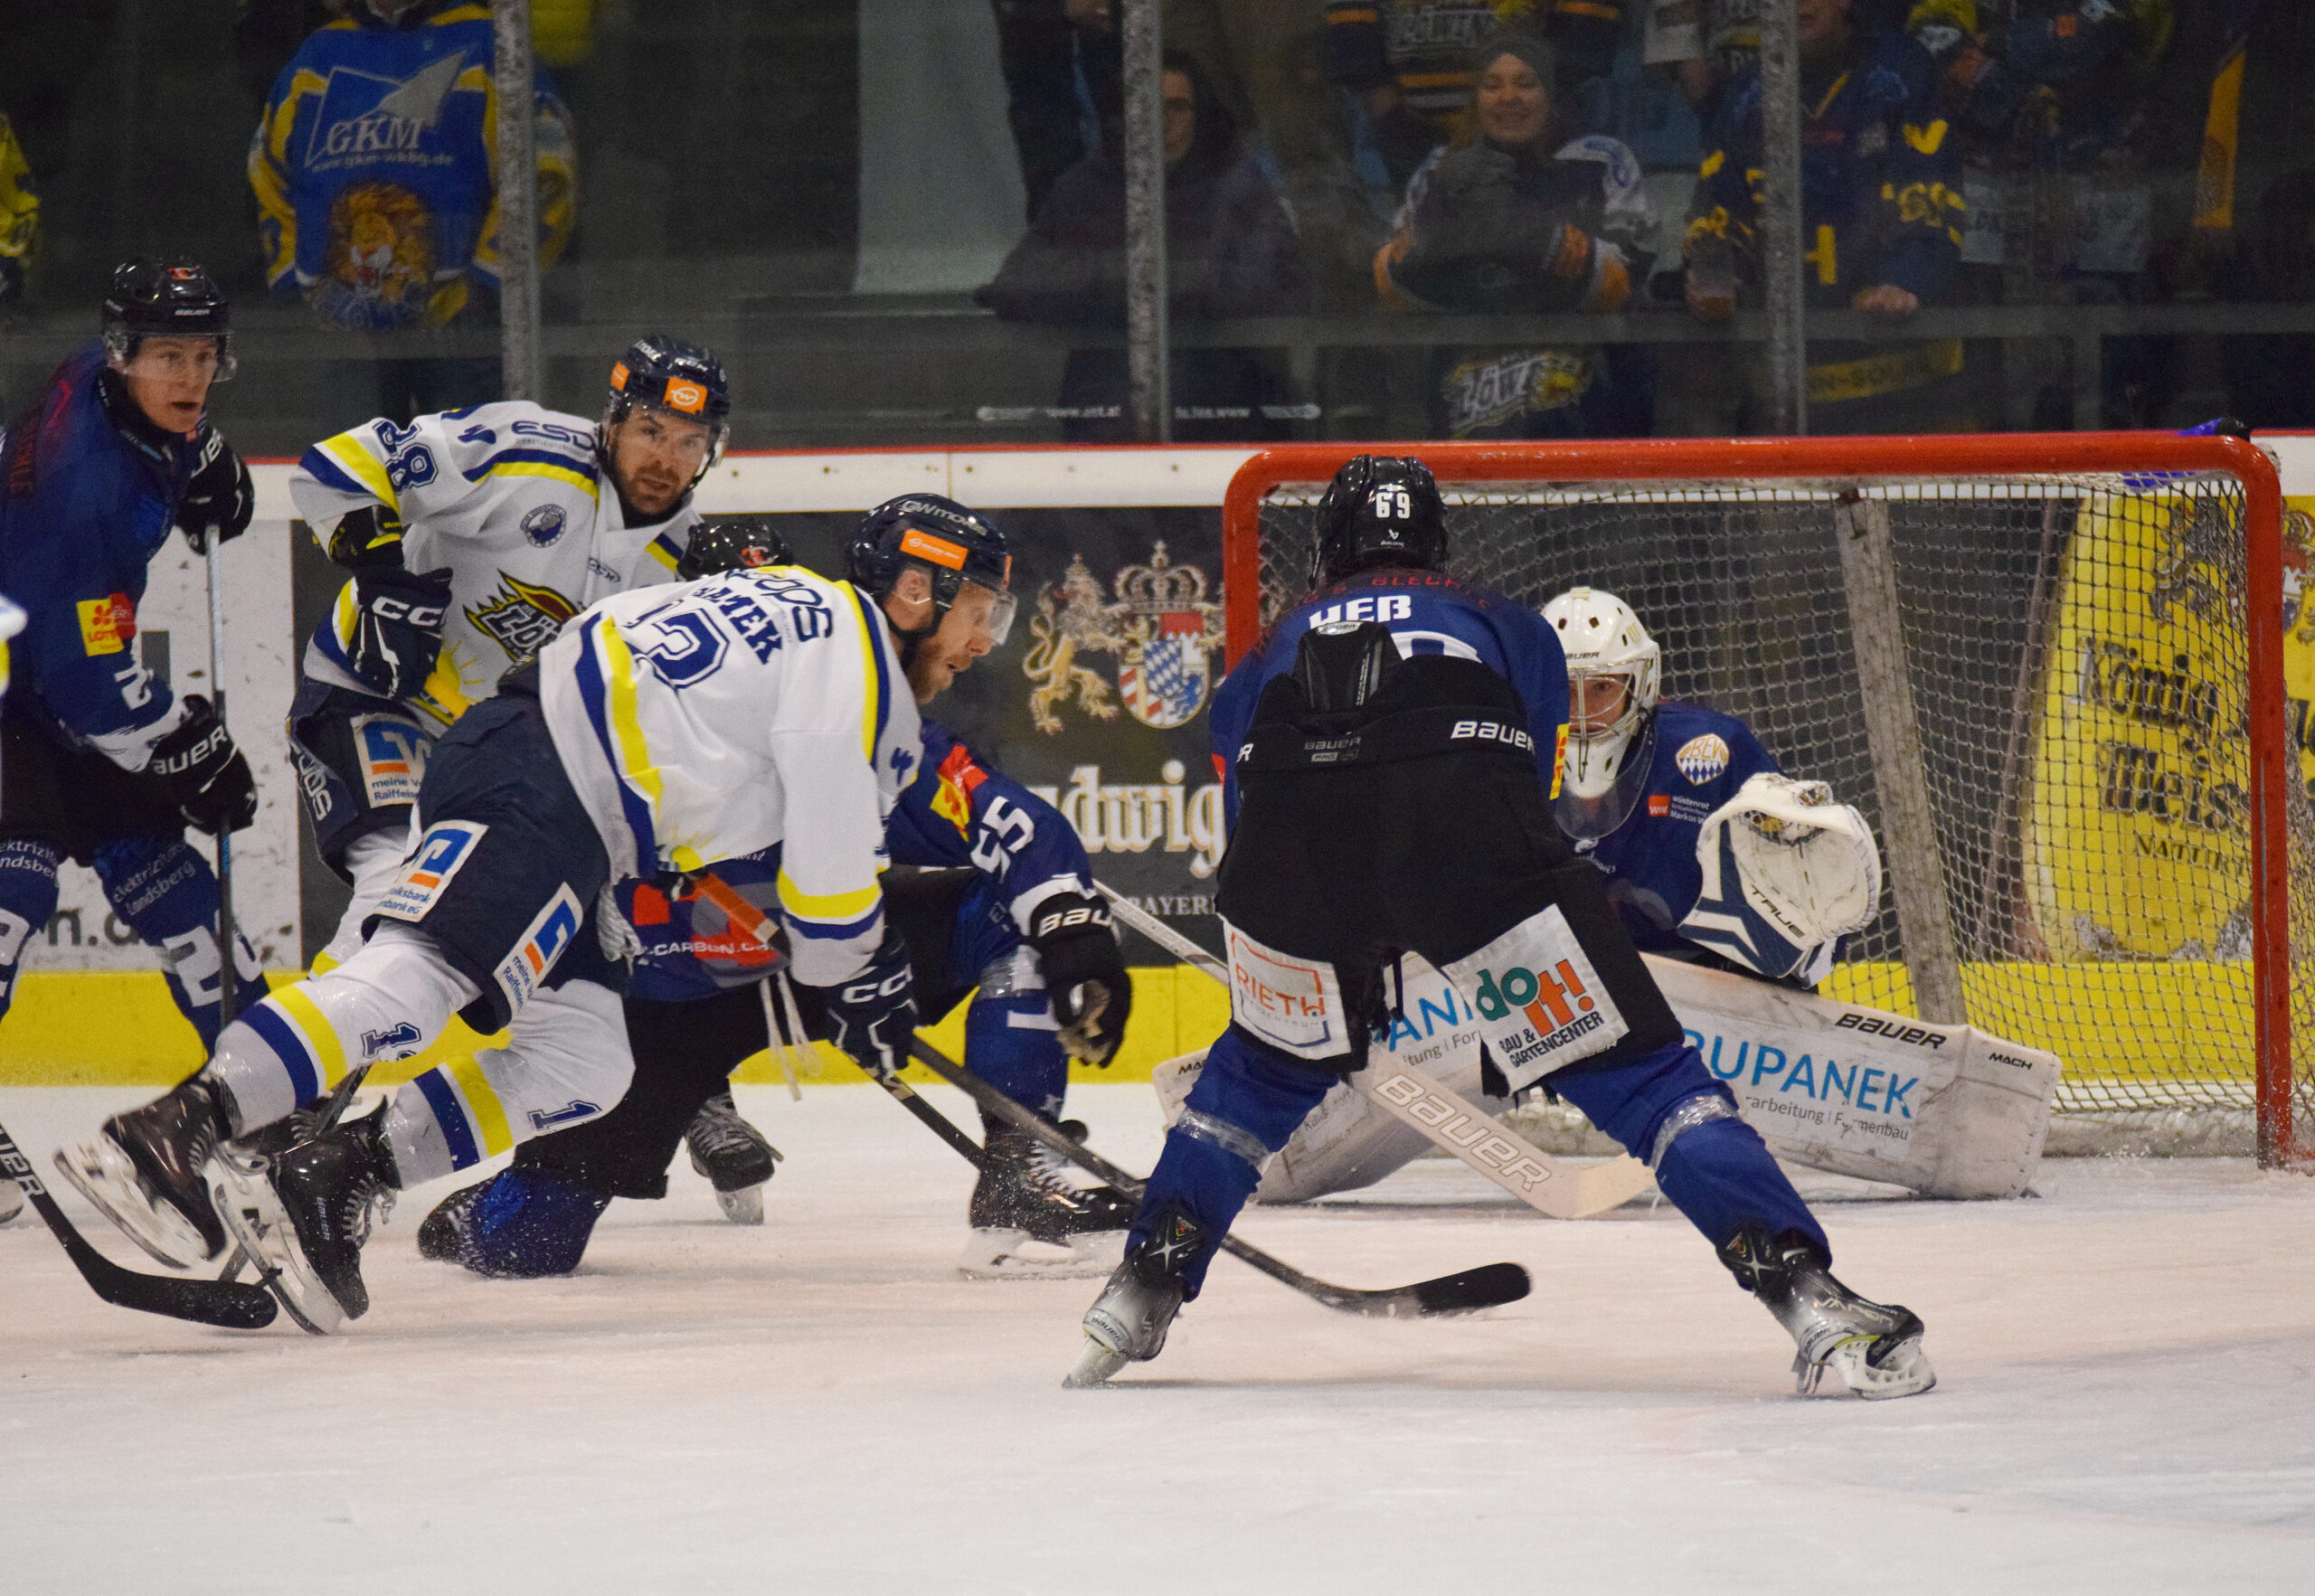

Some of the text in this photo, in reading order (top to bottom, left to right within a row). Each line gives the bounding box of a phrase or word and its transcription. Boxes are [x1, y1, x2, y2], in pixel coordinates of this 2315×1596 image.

[1375, 492, 1411, 520] 69
[1235, 961, 1327, 1017] RIETH
[1476, 966, 1538, 1022] do
[1989, 1052, 2033, 1071] MACH
